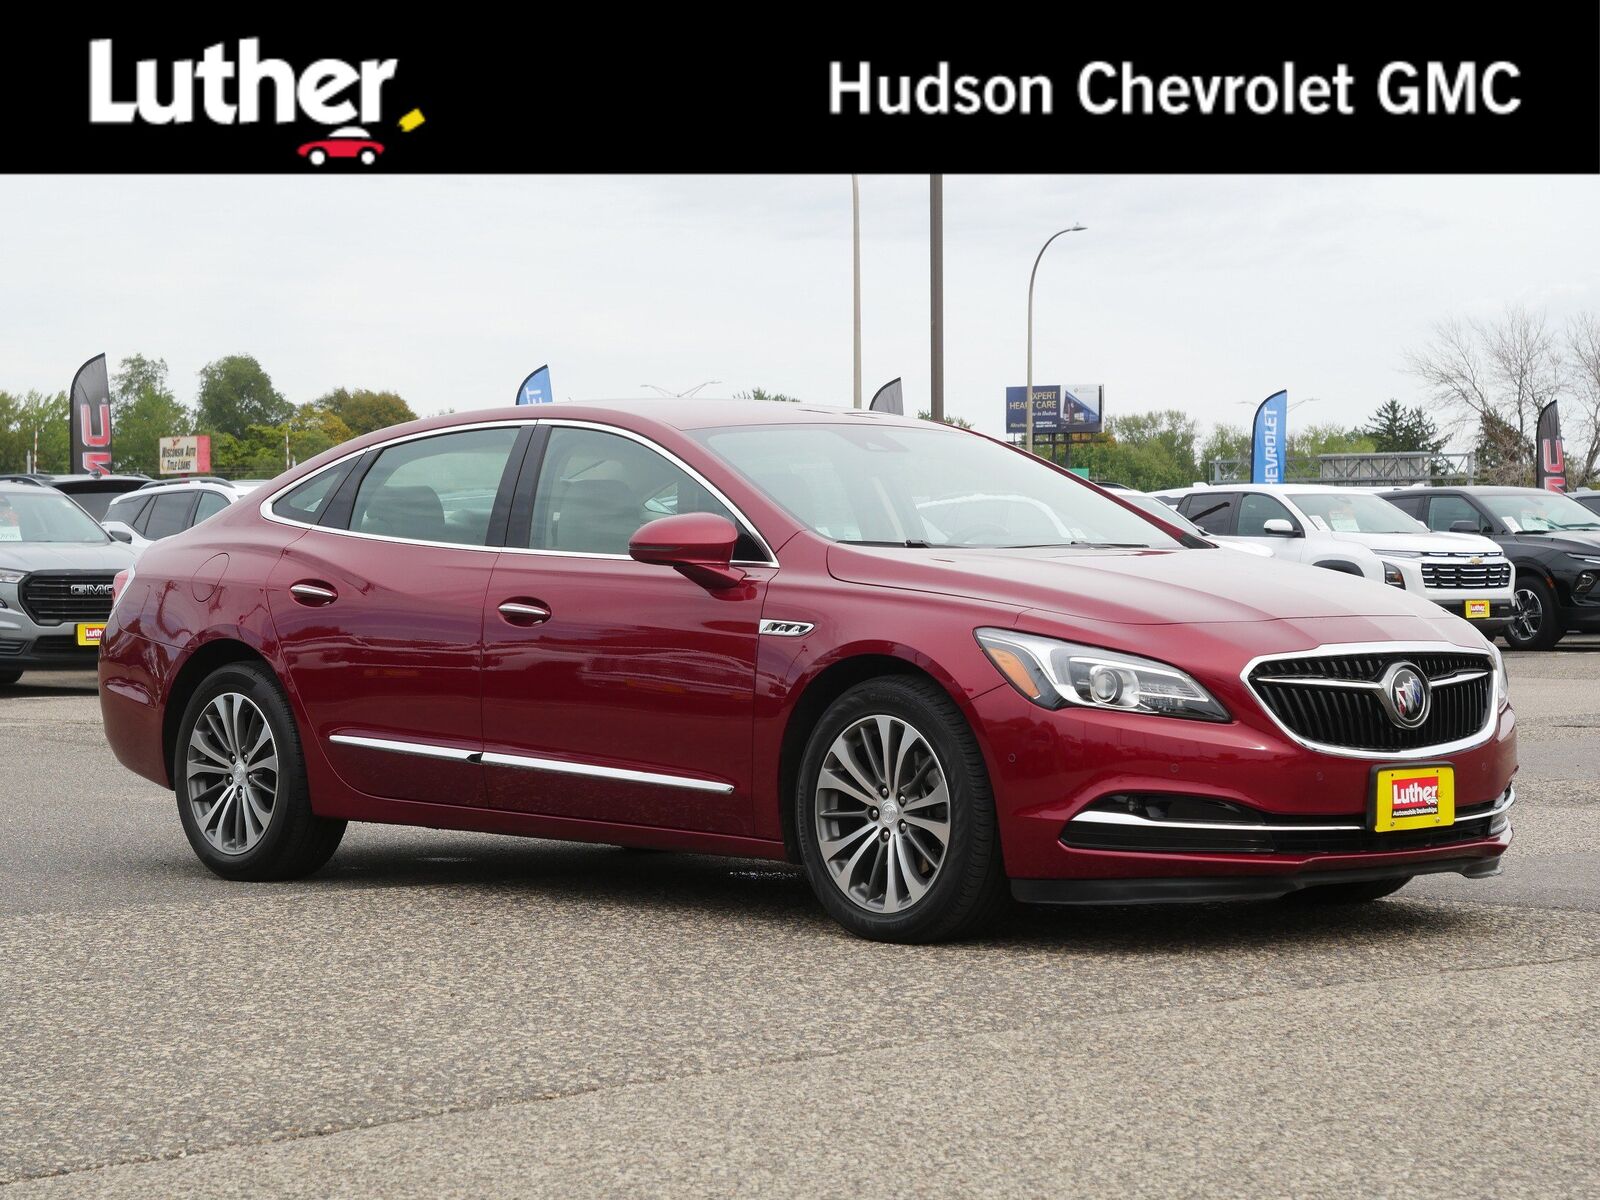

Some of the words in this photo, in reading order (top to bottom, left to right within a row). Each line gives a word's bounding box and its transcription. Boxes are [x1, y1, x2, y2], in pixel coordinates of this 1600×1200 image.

[1032, 392, 1057, 400] XPERT
[85, 628, 102, 637] Luth
[1394, 783, 1437, 804] Luther
